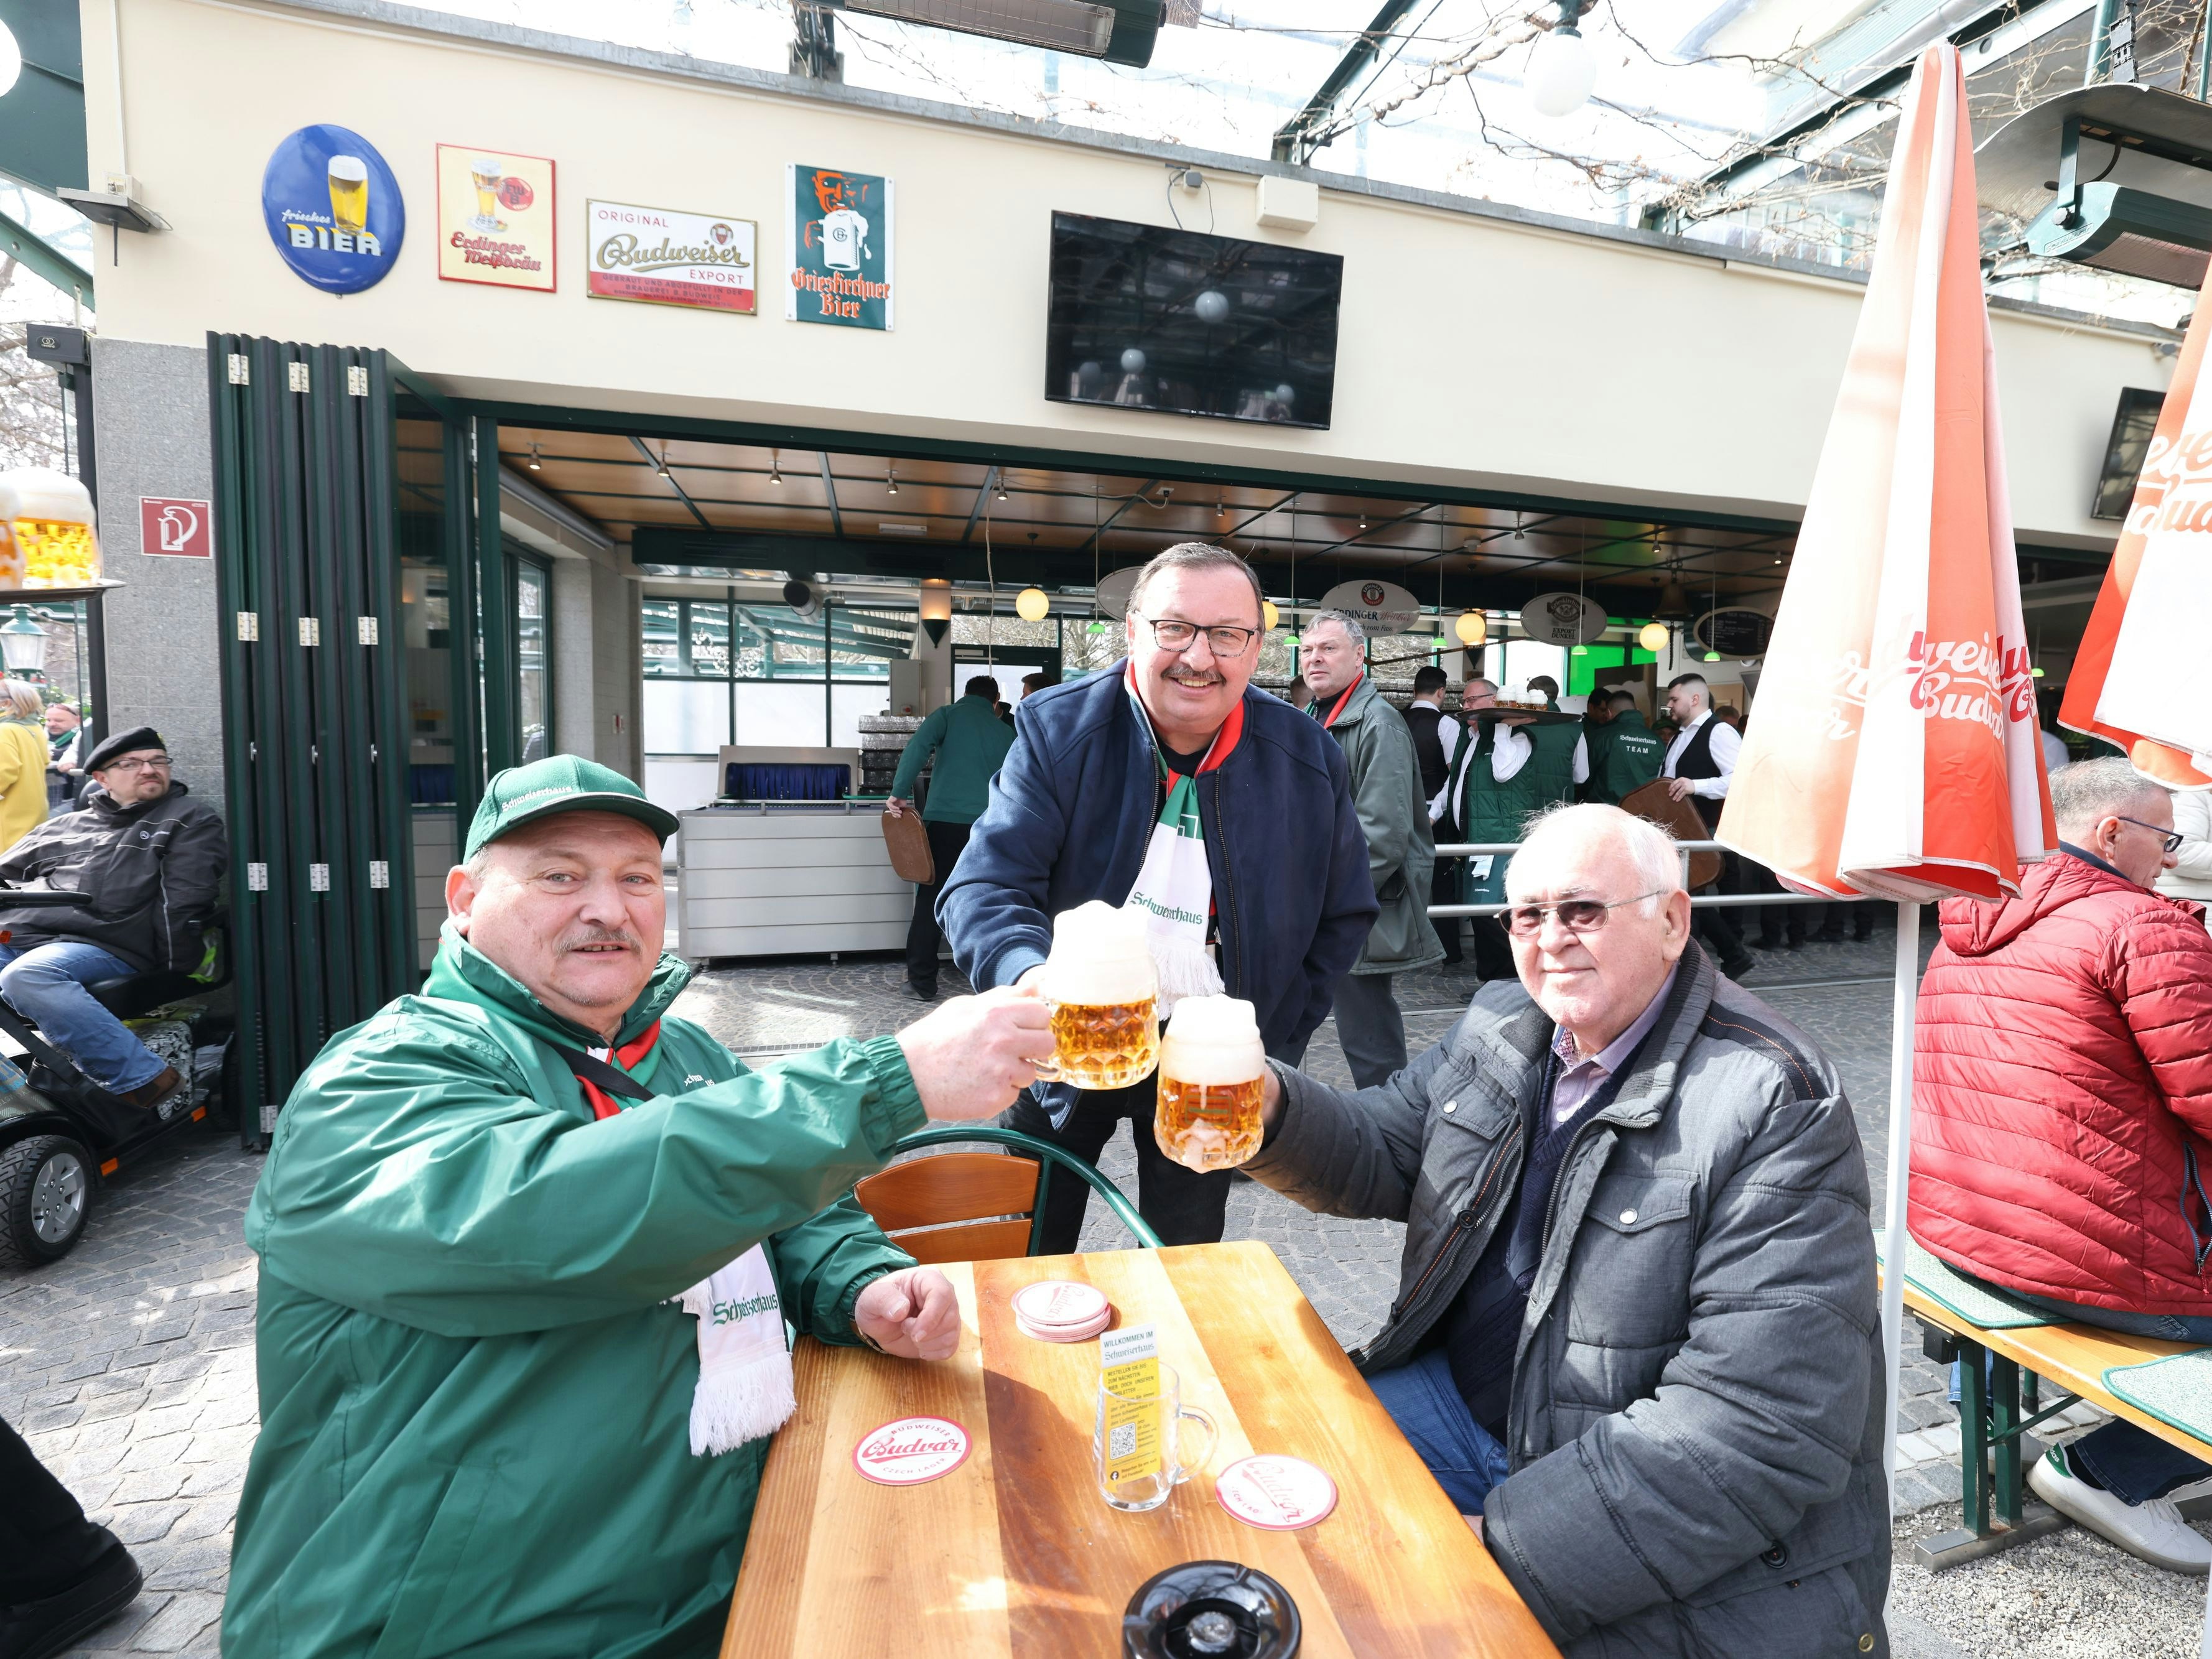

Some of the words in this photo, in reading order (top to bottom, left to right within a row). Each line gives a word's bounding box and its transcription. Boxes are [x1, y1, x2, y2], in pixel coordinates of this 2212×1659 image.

[598, 210, 669, 228] ORIGINAL
[286, 223, 381, 257] BIER
[450, 231, 526, 256] Erdinger
[596, 233, 750, 270] Budweiser
[602, 273, 641, 284] GEBRAUT
[644, 278, 662, 286] UND
[689, 269, 745, 285] EXPORT
[791, 266, 891, 302] Grieskirchner
[819, 292, 862, 318] Bier
[1626, 745, 1649, 754] TEAM
[1104, 1333, 1145, 1349] WILLKOMMEN
[1146, 1331, 1154, 1339] IM
[1105, 1343, 1155, 1360] Schweizerhaus
[890, 1424, 951, 1438] BUDWEISER
[861, 1436, 962, 1459] Budvar
